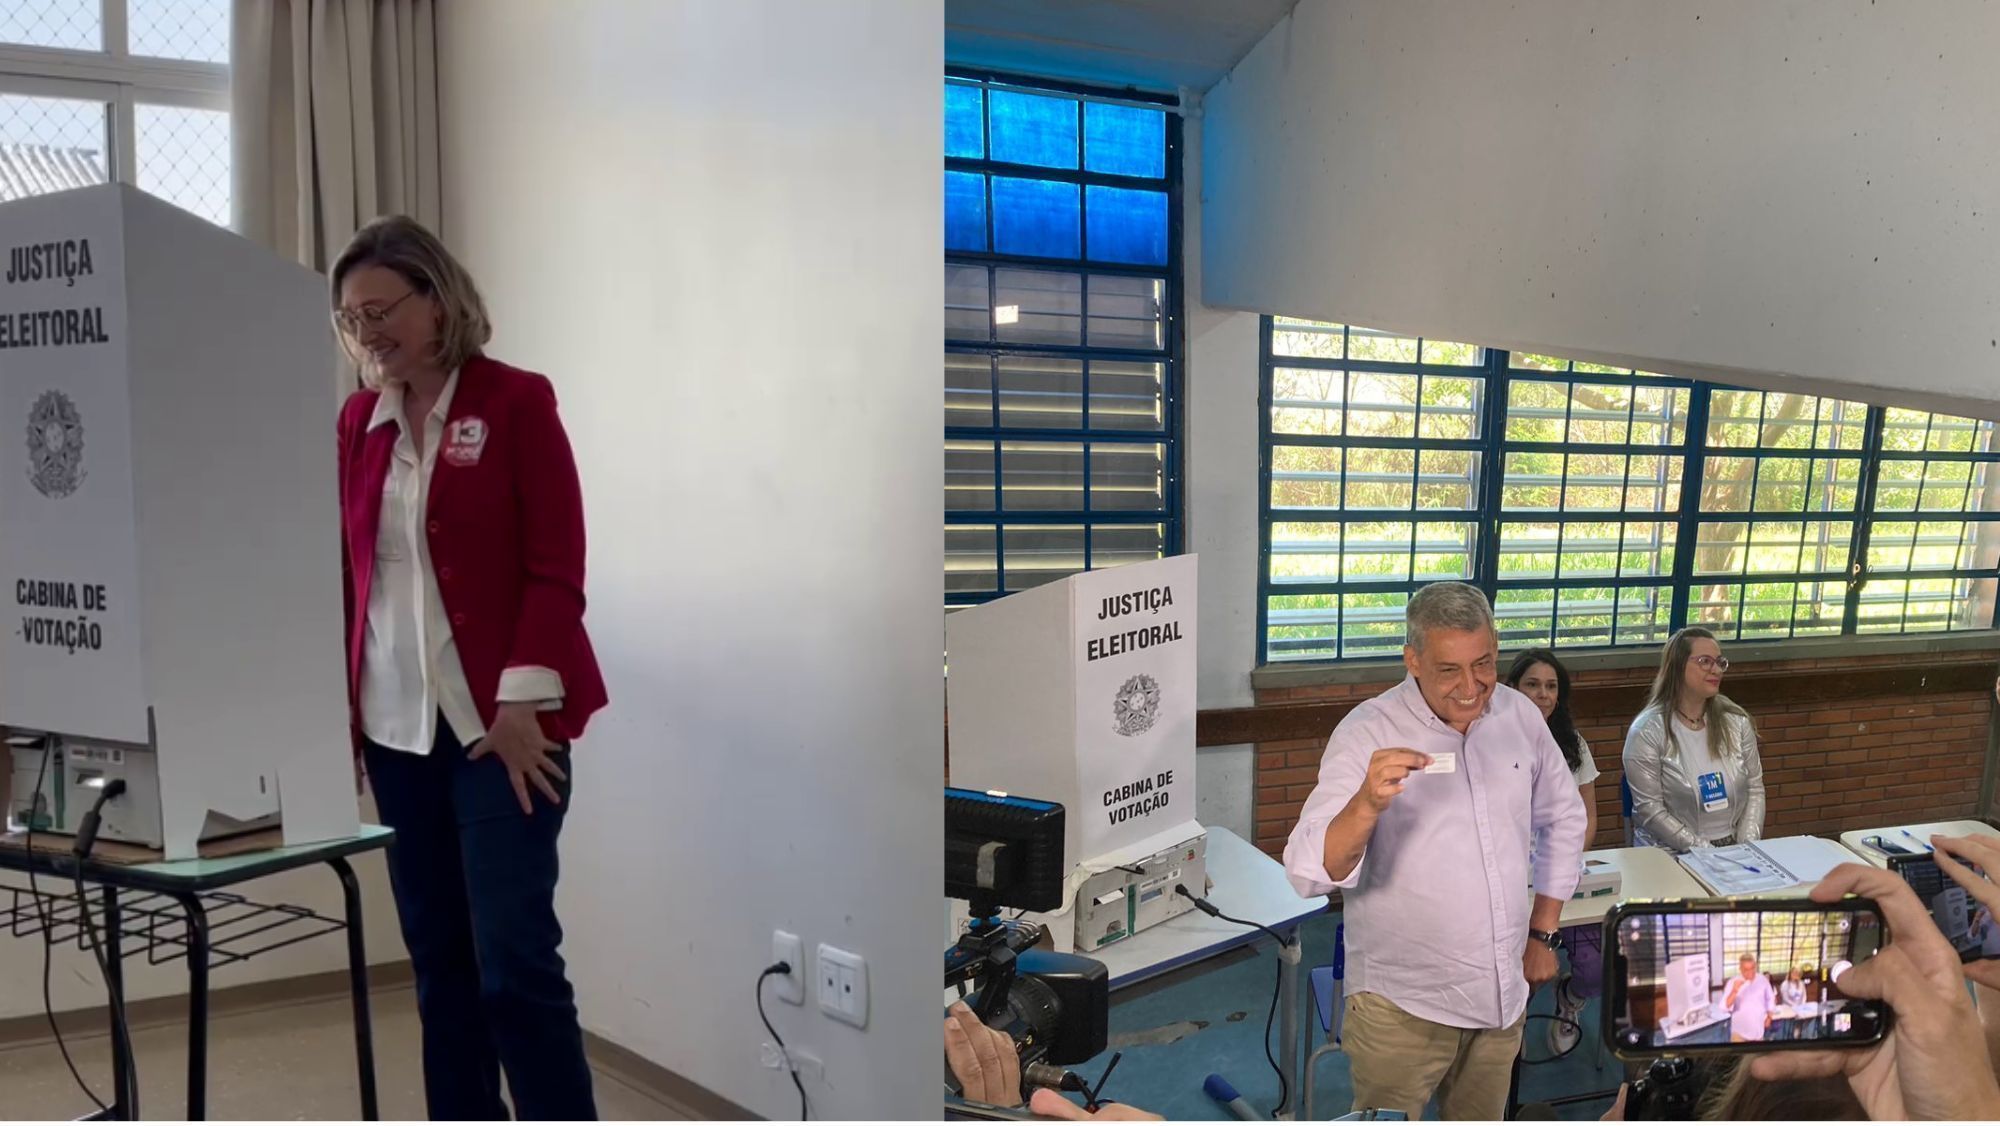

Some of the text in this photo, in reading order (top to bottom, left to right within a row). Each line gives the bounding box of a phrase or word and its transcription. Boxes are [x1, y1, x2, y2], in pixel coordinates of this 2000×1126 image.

[6, 238, 93, 287] JUSTIÇA
[0, 306, 109, 348] ELEITORAL
[451, 418, 483, 444] 13
[16, 578, 107, 611] CABINA DE
[1098, 586, 1173, 620] JUSTIÇA
[22, 615, 102, 655] VOTAÇÃO
[1087, 621, 1183, 662] ELEITORAL
[1103, 770, 1174, 806] CABINA DE
[1108, 791, 1169, 825] VOTAÇÃO
